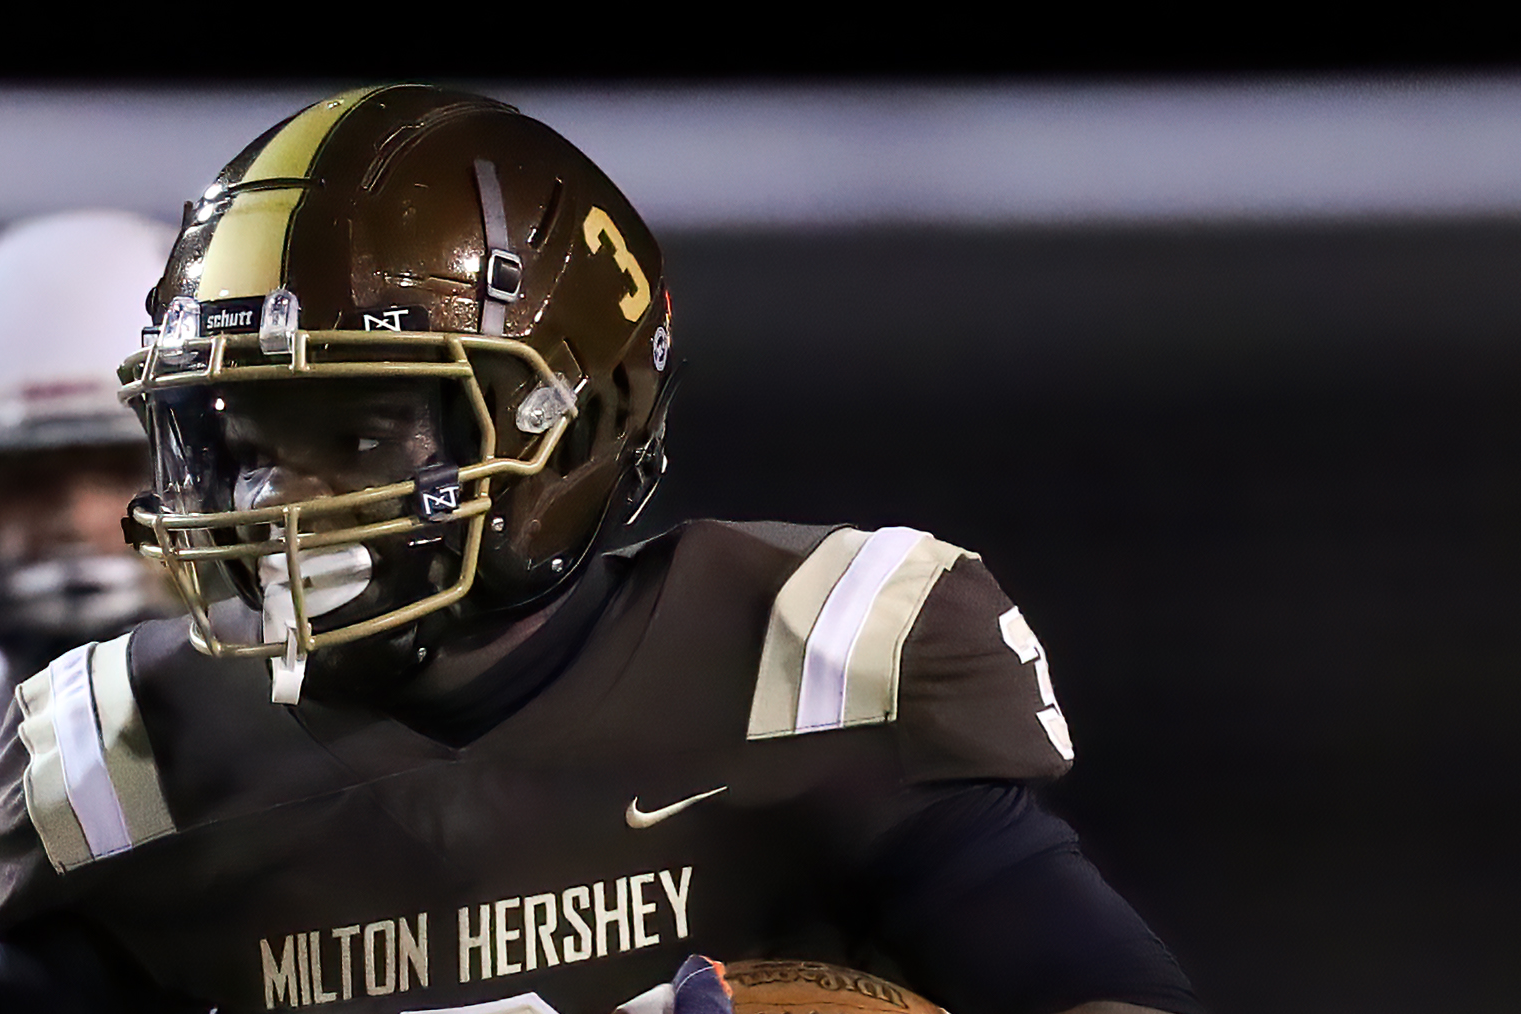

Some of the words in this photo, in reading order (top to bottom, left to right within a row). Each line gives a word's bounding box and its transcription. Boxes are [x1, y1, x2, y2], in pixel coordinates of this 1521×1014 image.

[583, 206, 651, 323] 3
[998, 605, 1075, 761] 3
[259, 912, 428, 1010] MILTON
[458, 866, 693, 983] HERSHEY
